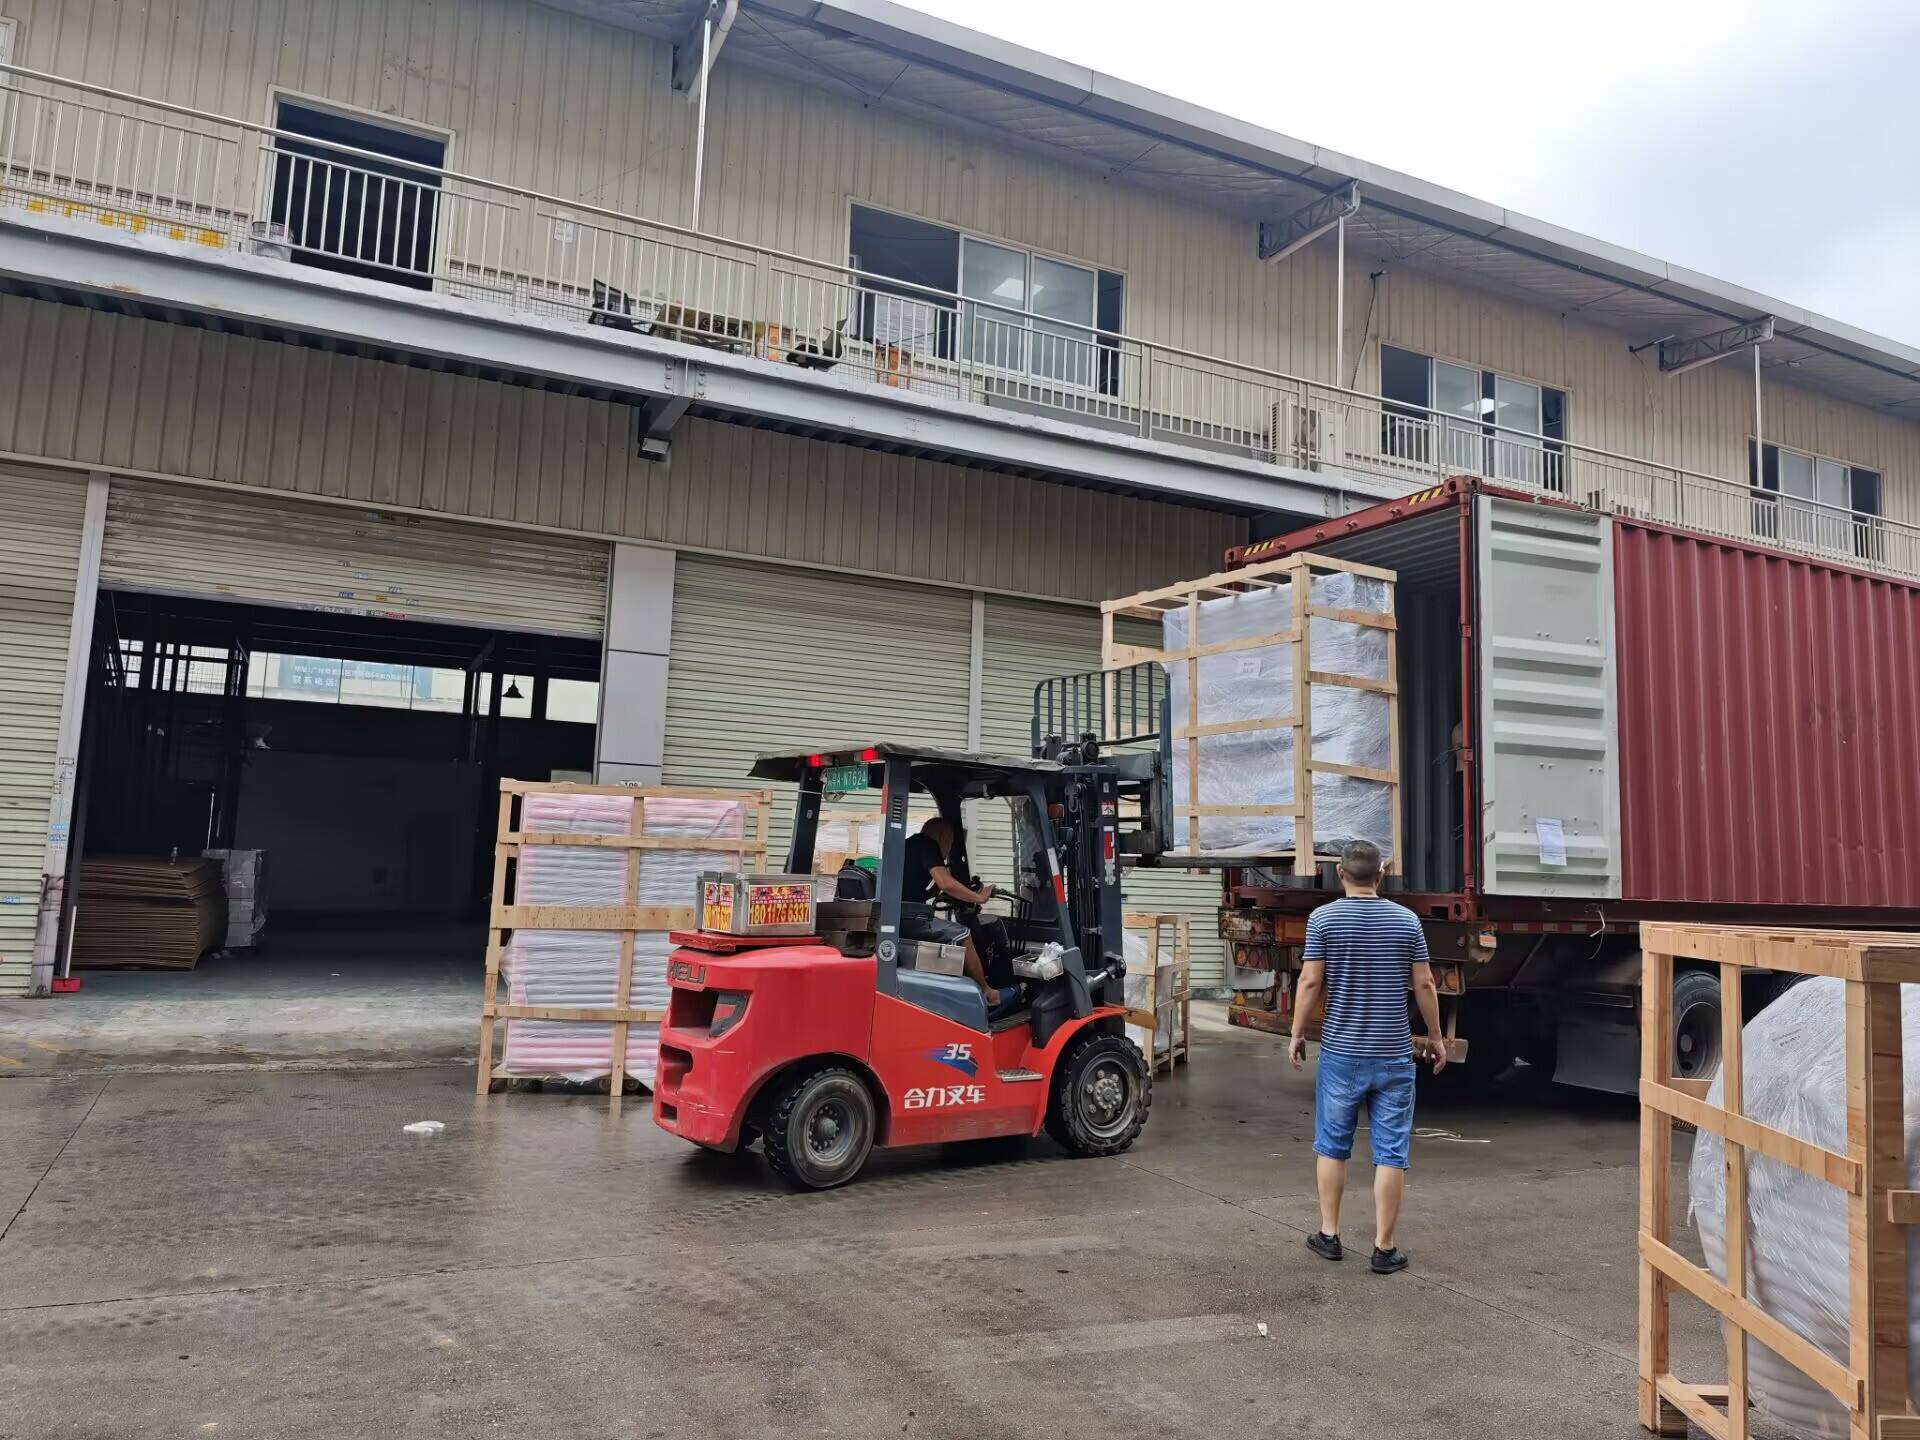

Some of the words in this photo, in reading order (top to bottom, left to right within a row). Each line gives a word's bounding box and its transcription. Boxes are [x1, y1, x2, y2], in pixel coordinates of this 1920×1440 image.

[670, 961, 705, 984] HELI
[943, 1042, 972, 1060] 35
[904, 1085, 986, 1109] 合力叉车
